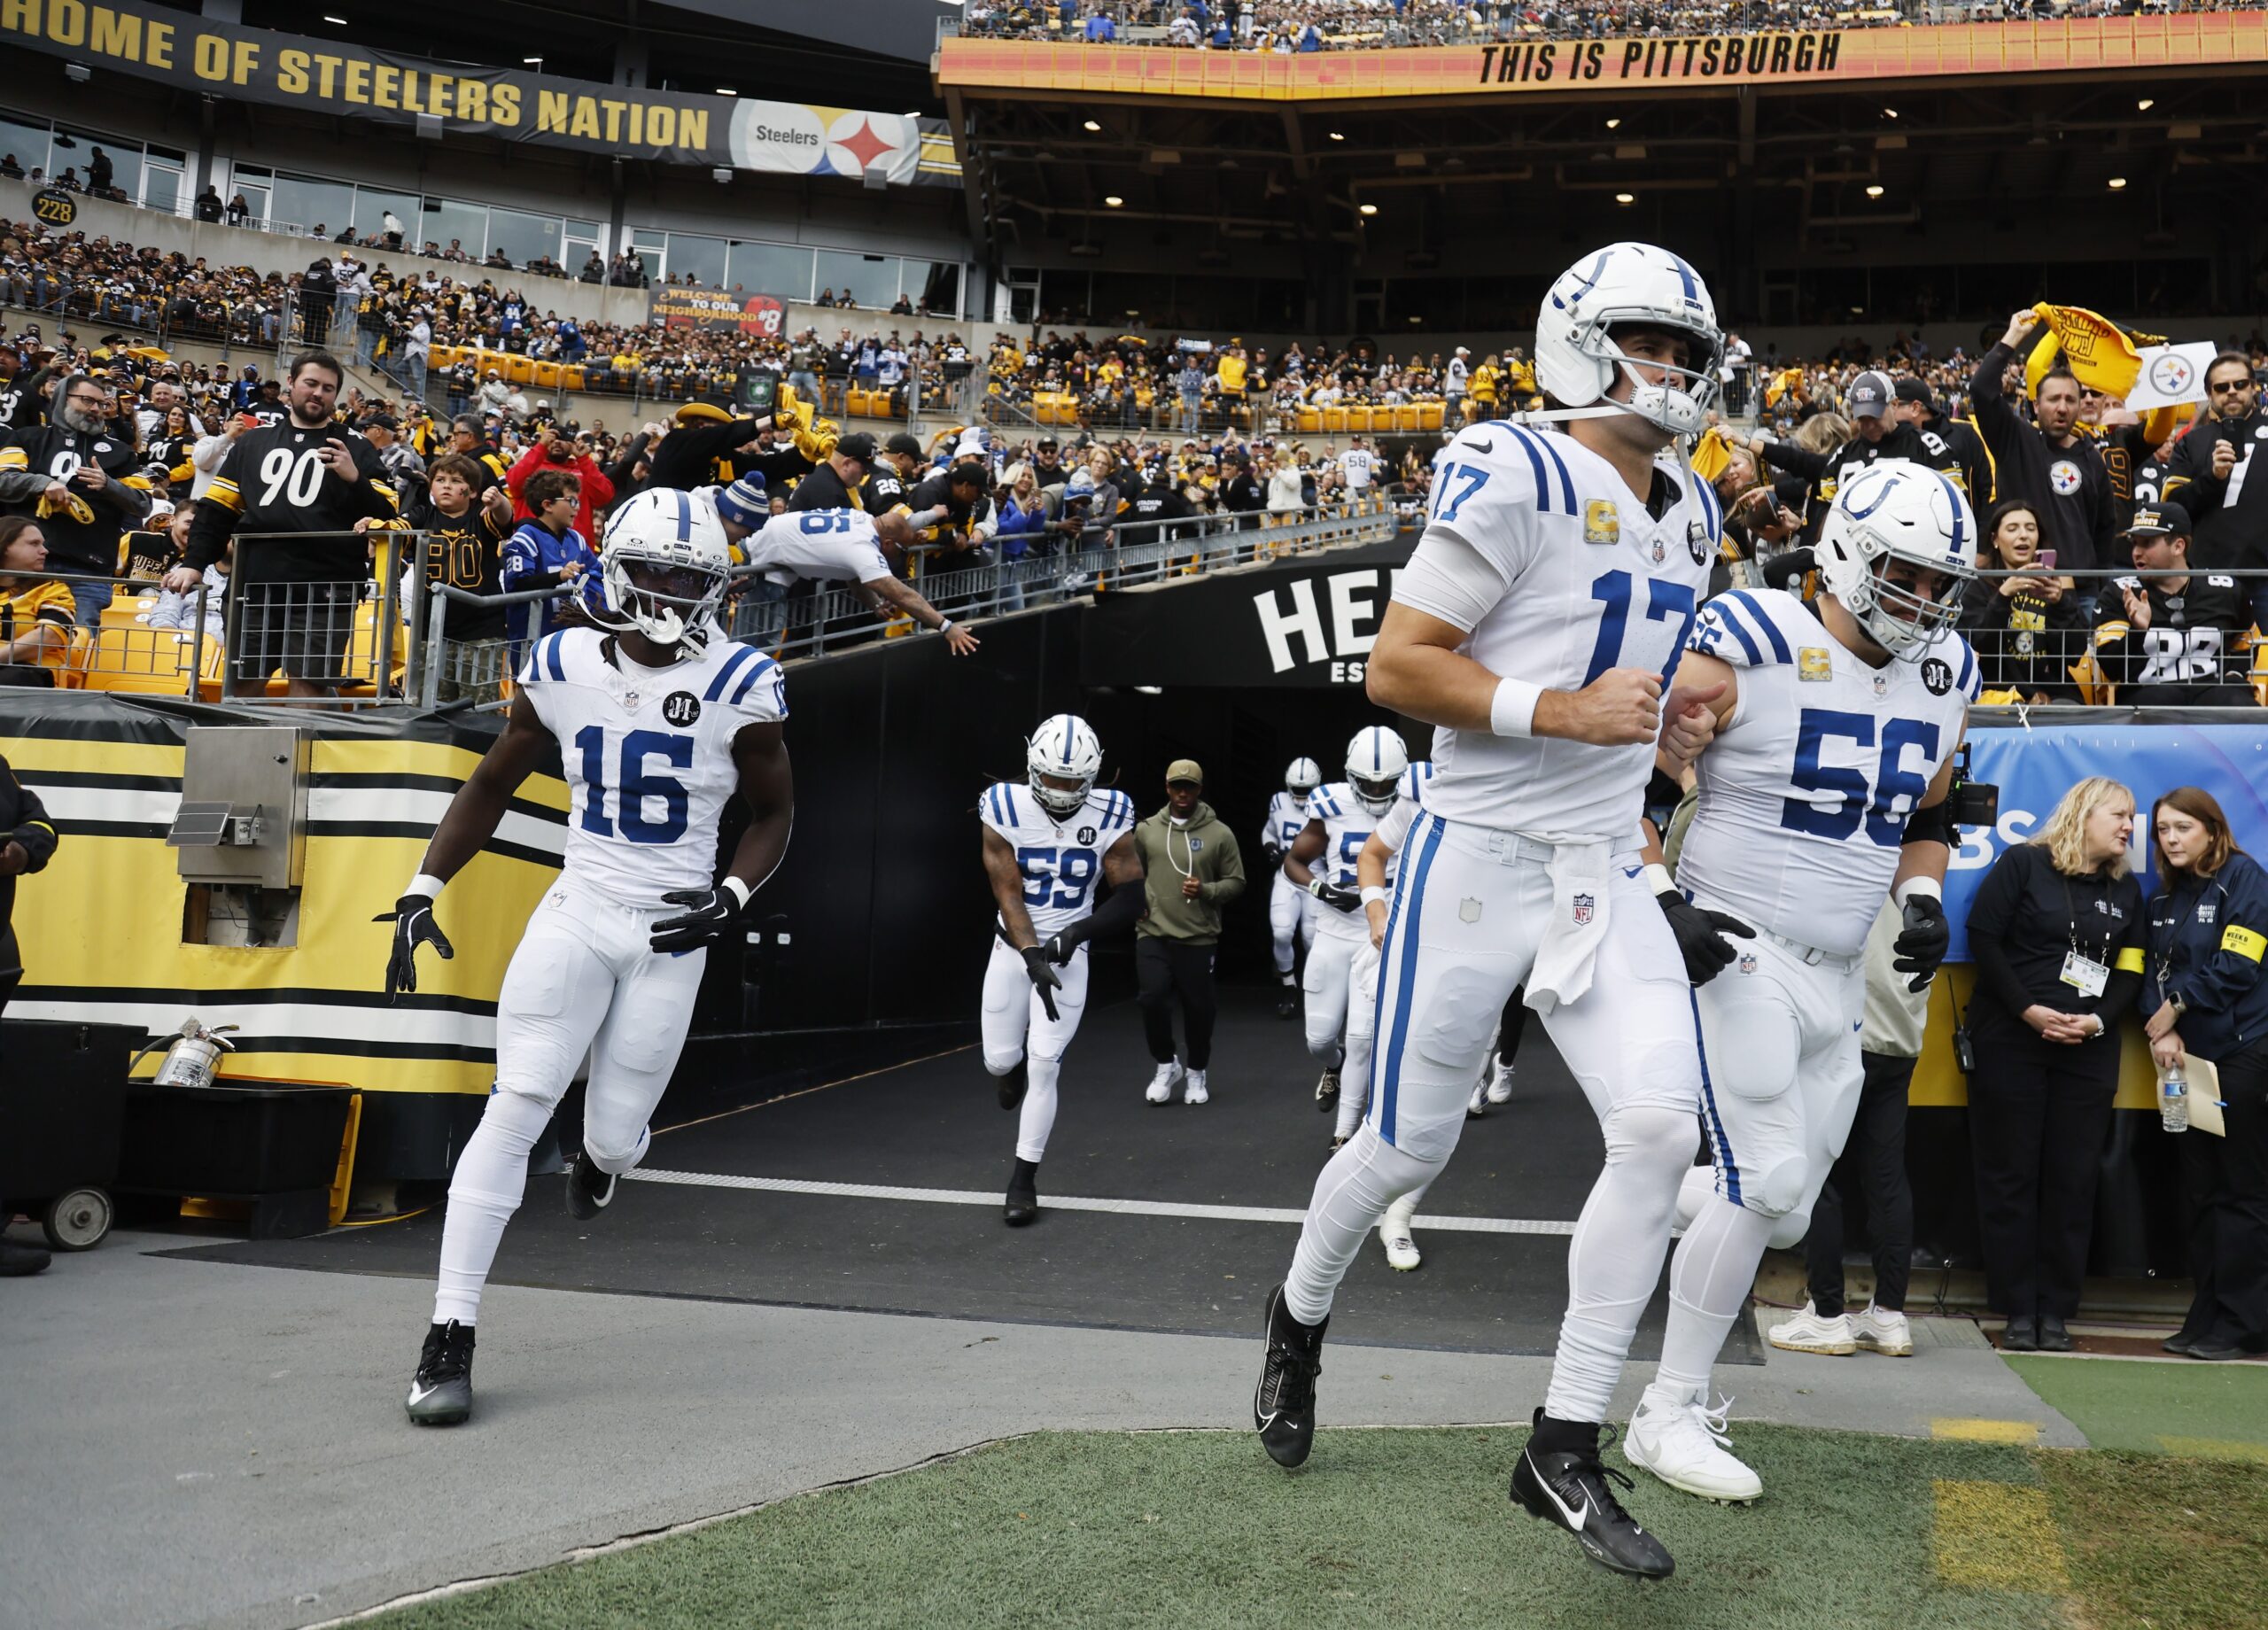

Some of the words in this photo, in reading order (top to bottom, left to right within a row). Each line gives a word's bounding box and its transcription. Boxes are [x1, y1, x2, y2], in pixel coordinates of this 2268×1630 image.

[1480, 44, 1557, 84] THIS
[1569, 42, 1605, 81] IS
[1620, 33, 1841, 79] PITTSBURGH
[2, 0, 175, 70] HOME
[194, 34, 260, 86] OF
[277, 49, 521, 128] STEELERS
[537, 89, 709, 151] NATION
[756, 124, 819, 147] Steelers
[37, 198, 73, 223] 228
[659, 289, 732, 302] WELCOME
[690, 299, 710, 309] TO
[711, 301, 740, 312] OUR
[652, 304, 757, 325] NEIGHBORHOOD
[757, 309, 781, 333] #8
[148, 440, 172, 461] 90
[1348, 455, 1367, 468] 58
[259, 447, 326, 508] 90
[874, 477, 902, 496] 26
[1433, 462, 1490, 523] 17
[425, 533, 483, 589] 90
[506, 555, 524, 572] 28
[1253, 569, 1405, 673] HE
[1581, 569, 1696, 700] 17
[2138, 625, 2222, 684] 88
[1331, 662, 1368, 683] ES
[575, 725, 695, 844] 16
[1781, 708, 1940, 847] 56
[1017, 846, 1099, 909] 59
[2226, 931, 2244, 942] WEEK
